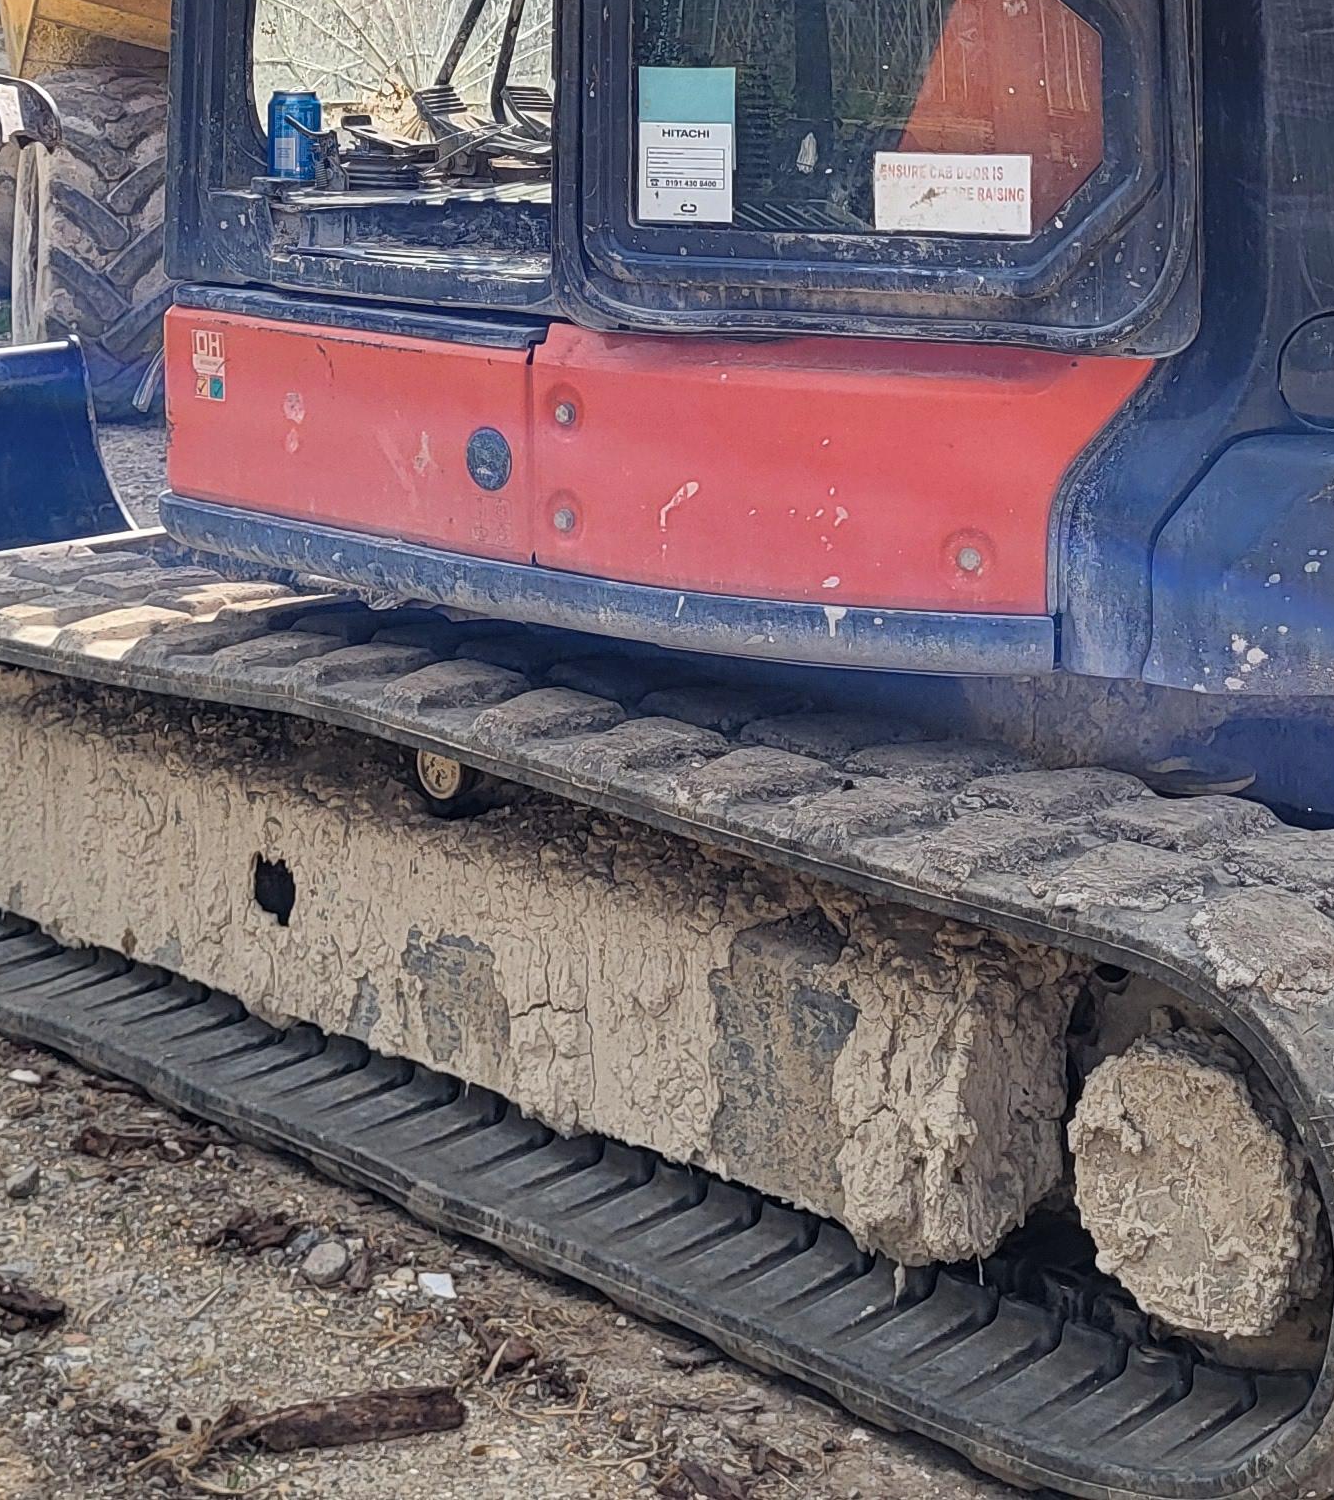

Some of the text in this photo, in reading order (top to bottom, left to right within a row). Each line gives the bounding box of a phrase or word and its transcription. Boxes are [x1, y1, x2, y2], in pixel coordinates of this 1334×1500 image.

[661, 128, 710, 139] HITACHI
[879, 163, 1004, 182] ENSURE CAB DOOR IS
[977, 187, 1026, 203] RAISING
